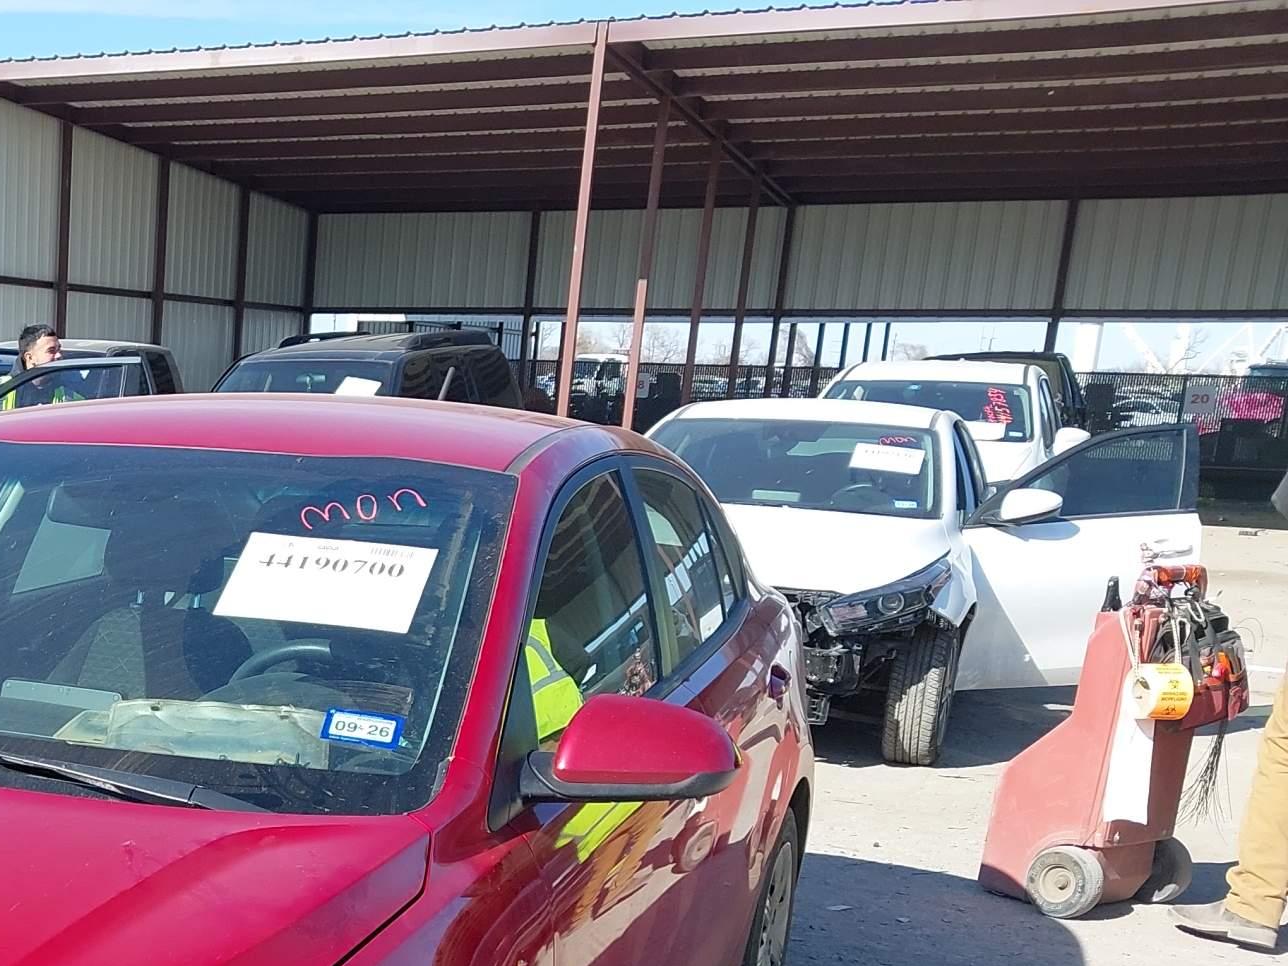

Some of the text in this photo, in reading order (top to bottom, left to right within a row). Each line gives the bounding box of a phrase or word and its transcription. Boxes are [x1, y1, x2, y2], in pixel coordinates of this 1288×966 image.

[1191, 393, 1210, 404] 20
[259, 553, 405, 578] 44190700
[367, 724, 390, 738] 26
